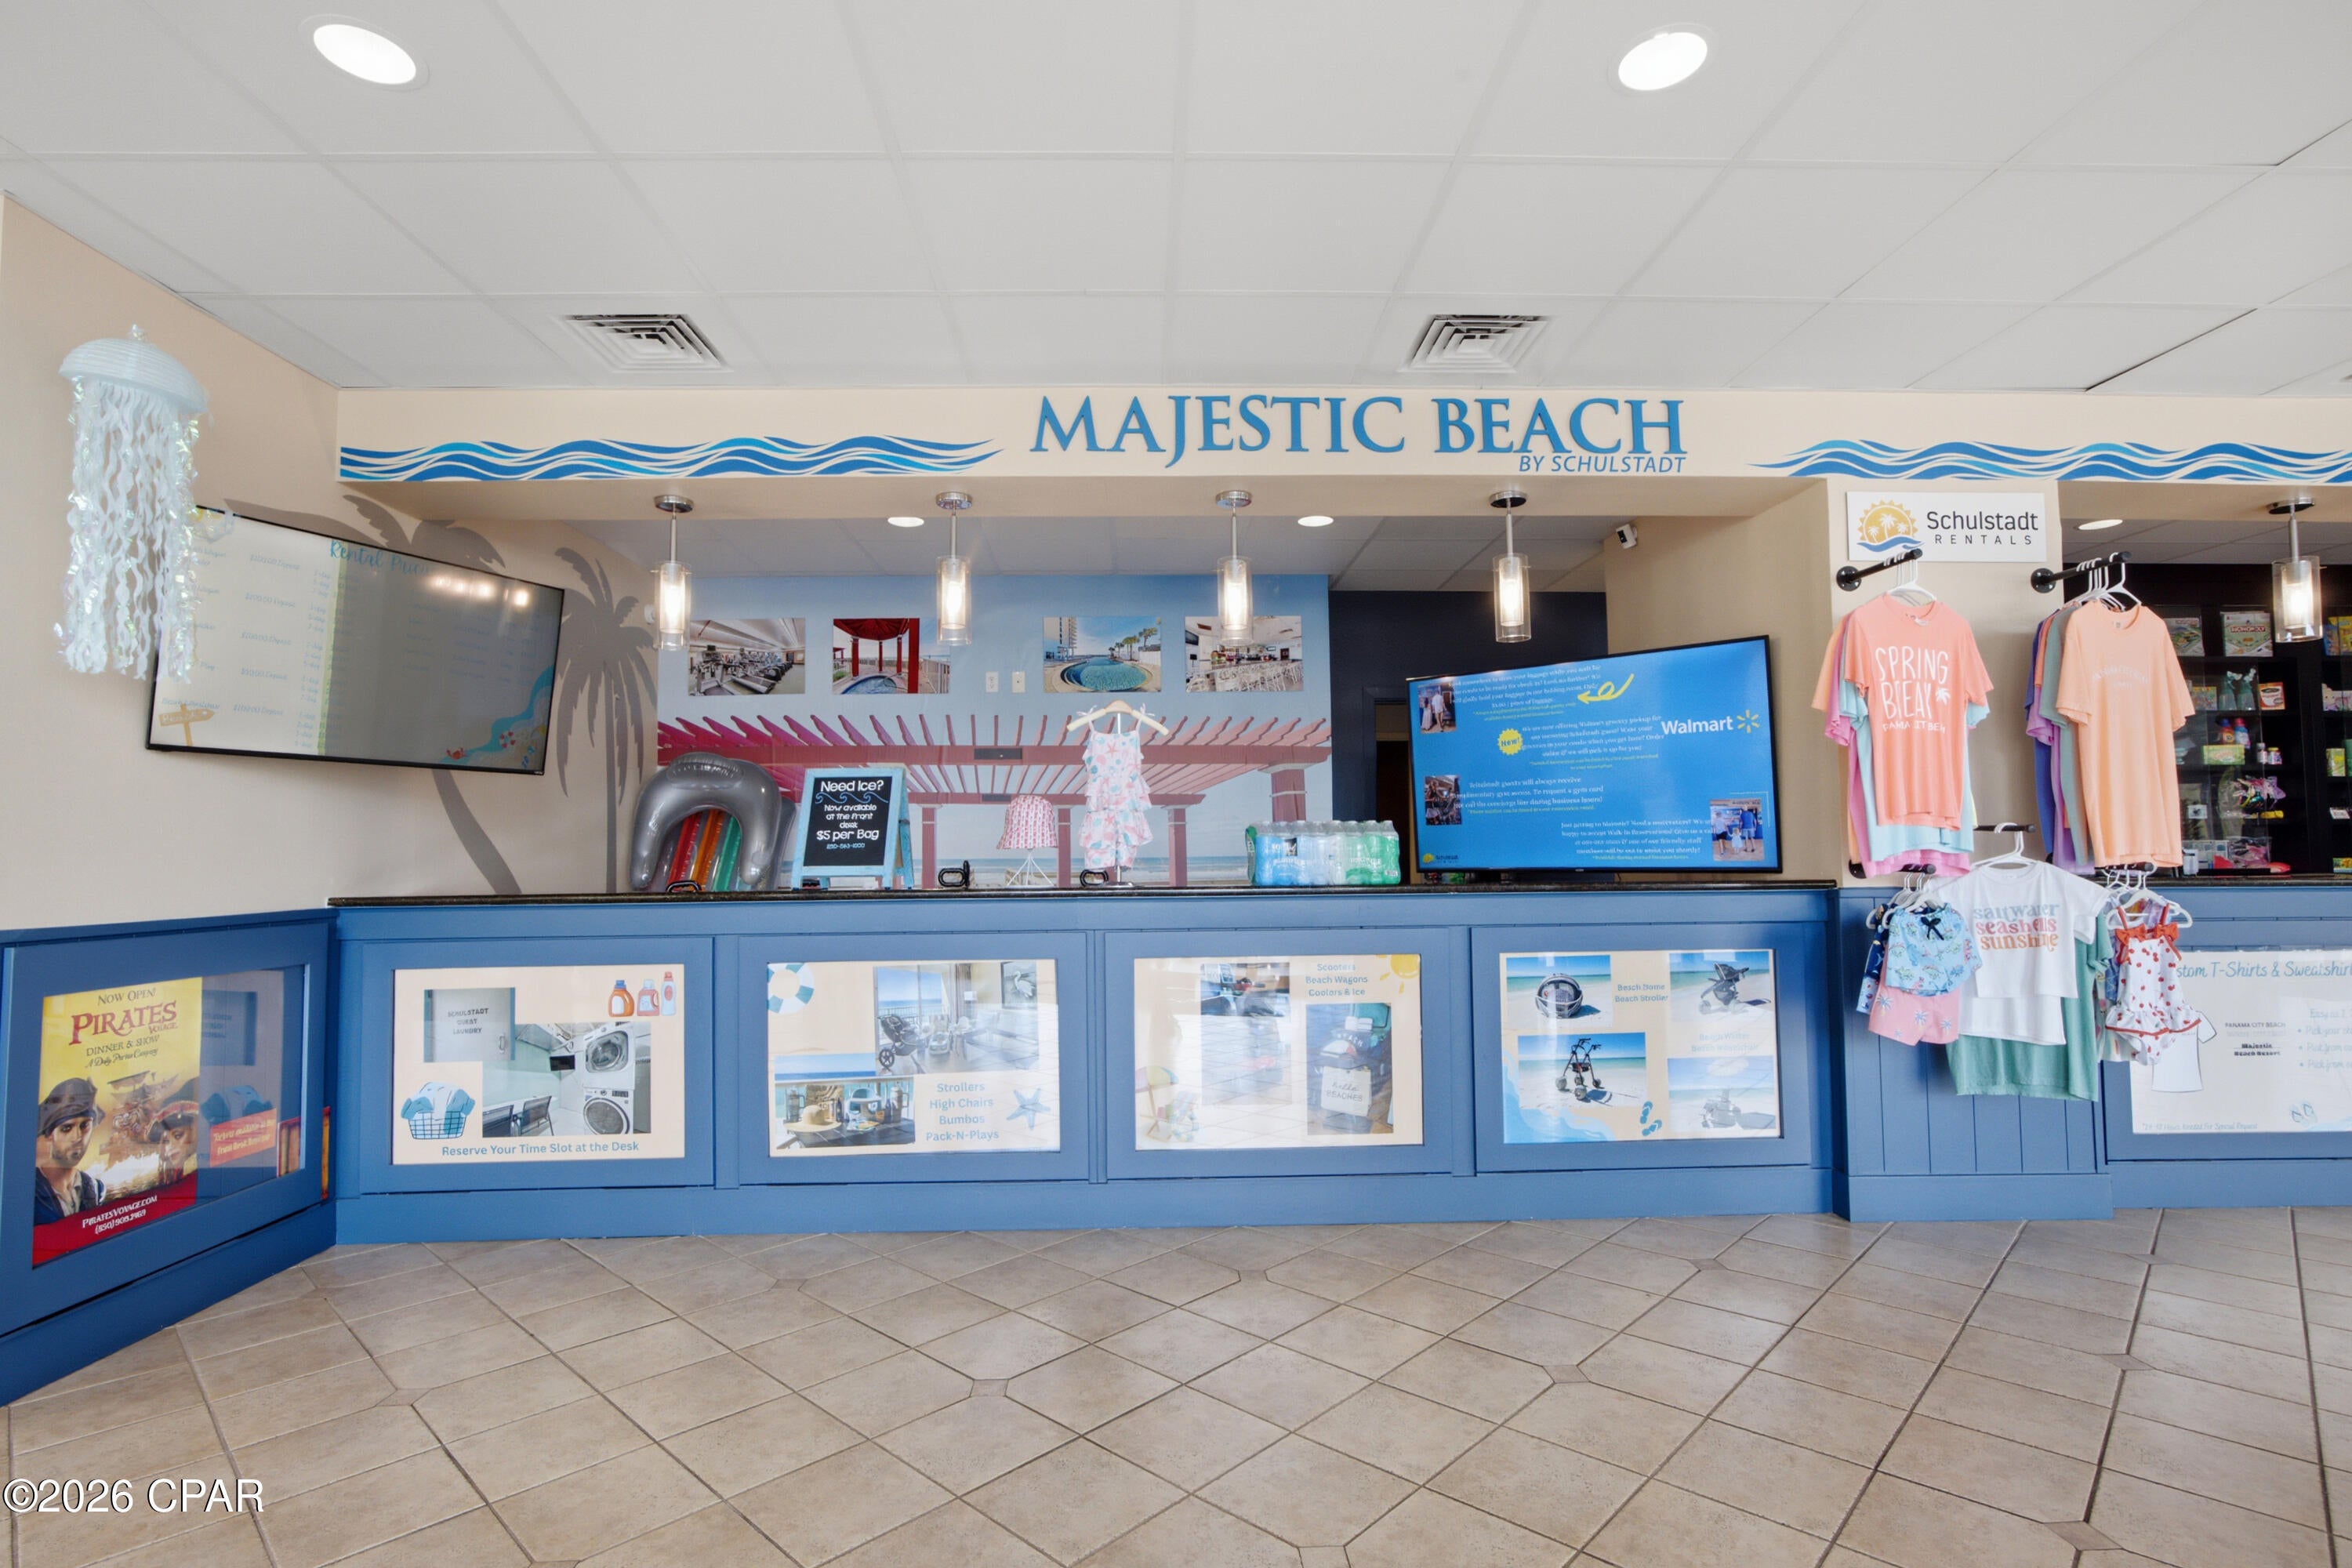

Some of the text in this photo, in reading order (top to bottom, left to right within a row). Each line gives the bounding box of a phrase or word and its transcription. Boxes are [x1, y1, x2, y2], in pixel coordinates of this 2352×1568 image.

[1029, 394, 1689, 470] MAJESTIC BEACH
[1519, 456, 1687, 474] BY SCHULSTADT
[1926, 510, 2039, 531] Schulstadt
[1934, 534, 2032, 545] RENTALS
[330, 540, 383, 568] Rental
[1875, 645, 1949, 684] SPRING
[1661, 714, 1734, 736] Walmart
[821, 779, 884, 792] Need Ice?
[817, 829, 879, 842] $5 per Bag
[1317, 963, 1356, 972] Scooters
[2176, 964, 2207, 978] stom
[2210, 960, 2267, 978] T-Shirts
[2269, 961, 2280, 977] &
[1305, 975, 1368, 985] Beach Wagons
[97, 987, 156, 1006] NOW OPEN!
[1640, 994, 1668, 1003] Stroller
[68, 1000, 178, 1046] PIRATES
[85, 1033, 160, 1057] DINNER & SHOW
[937, 1083, 985, 1093] Strollers
[929, 1098, 994, 1111] High Chairs
[939, 1115, 985, 1125] Bumbos
[926, 1130, 1000, 1142] Pack-N-Plays
[441, 1142, 639, 1156] Reserve Your Time Slot at the Desk
